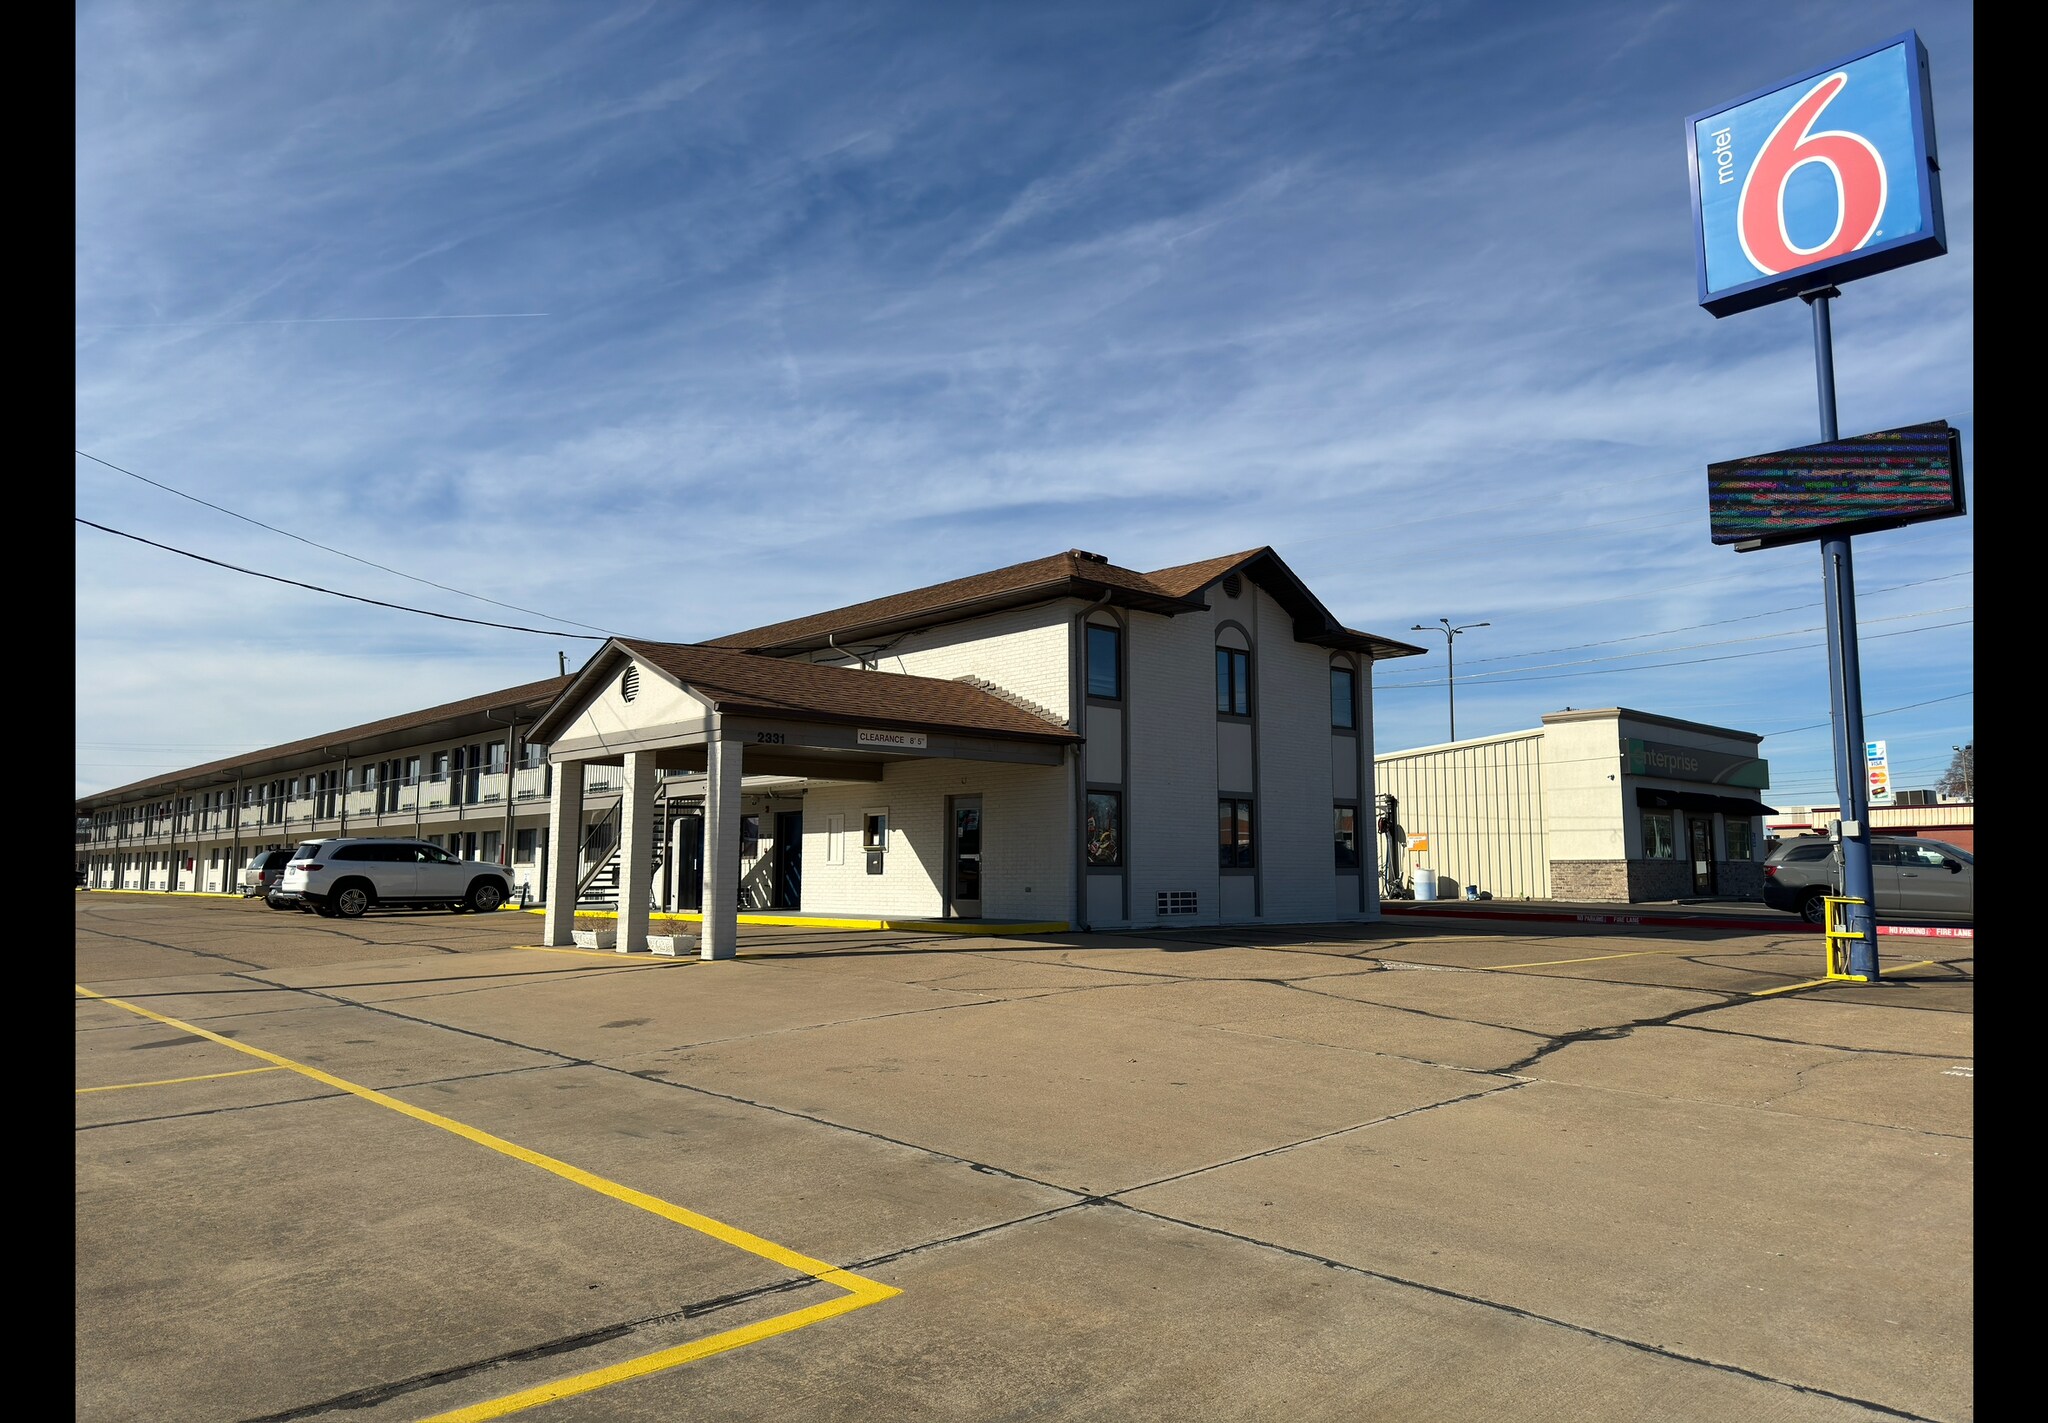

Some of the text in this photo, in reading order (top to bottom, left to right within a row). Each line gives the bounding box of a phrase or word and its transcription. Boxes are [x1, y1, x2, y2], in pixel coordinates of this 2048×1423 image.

[1711, 71, 1888, 276] motel 6
[757, 732, 785, 745] 2331
[859, 732, 905, 744] CLEARANCE
[1633, 747, 1699, 774] enterprise
[1889, 926, 1973, 937] NO PARKING FIRE LANE
